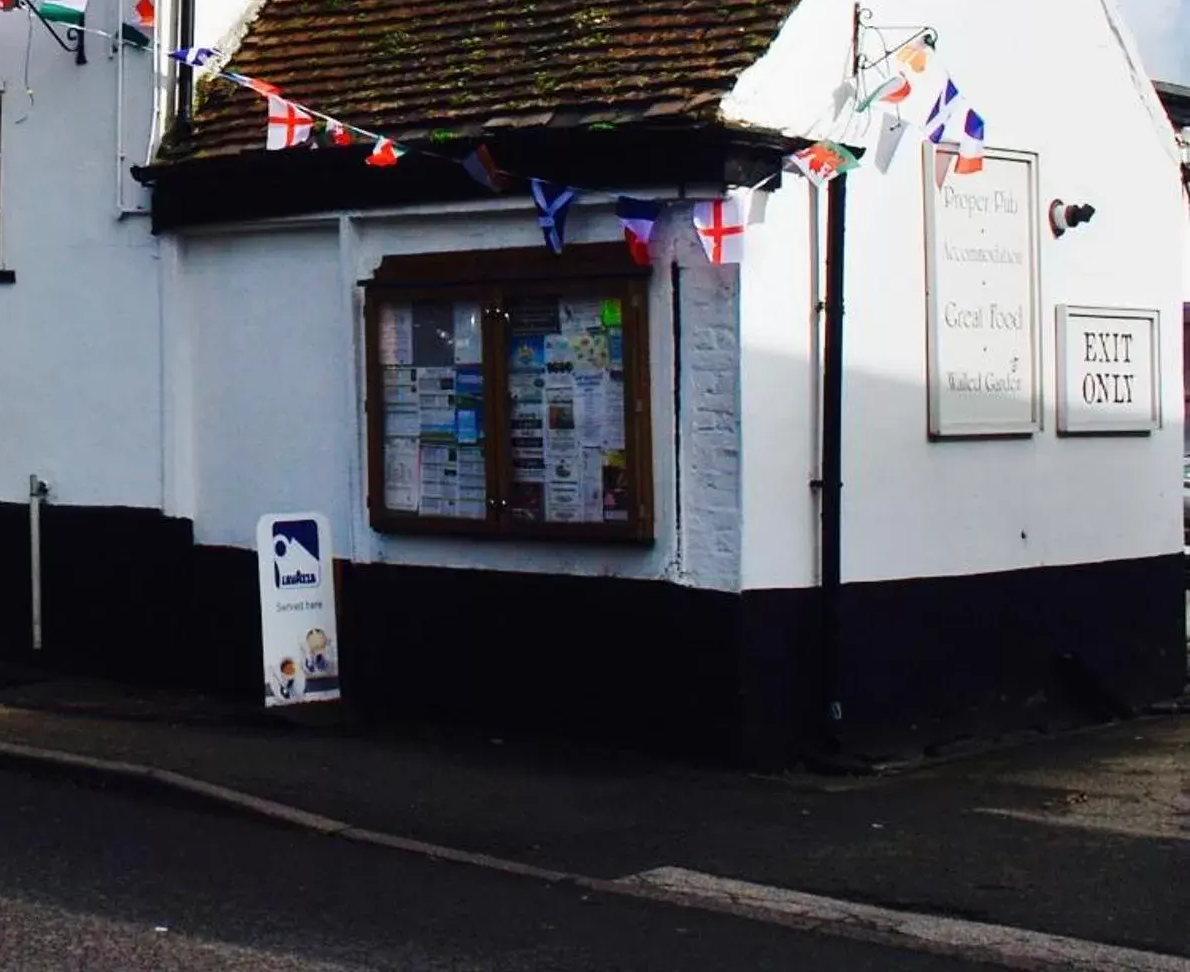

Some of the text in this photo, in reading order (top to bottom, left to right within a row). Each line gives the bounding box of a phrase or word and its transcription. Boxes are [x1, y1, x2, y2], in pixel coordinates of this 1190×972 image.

[944, 186, 1018, 219] Proper Pub
[945, 301, 1022, 329] Great Food
[1084, 332, 1133, 362] EXIT
[1082, 373, 1134, 404] ONLY
